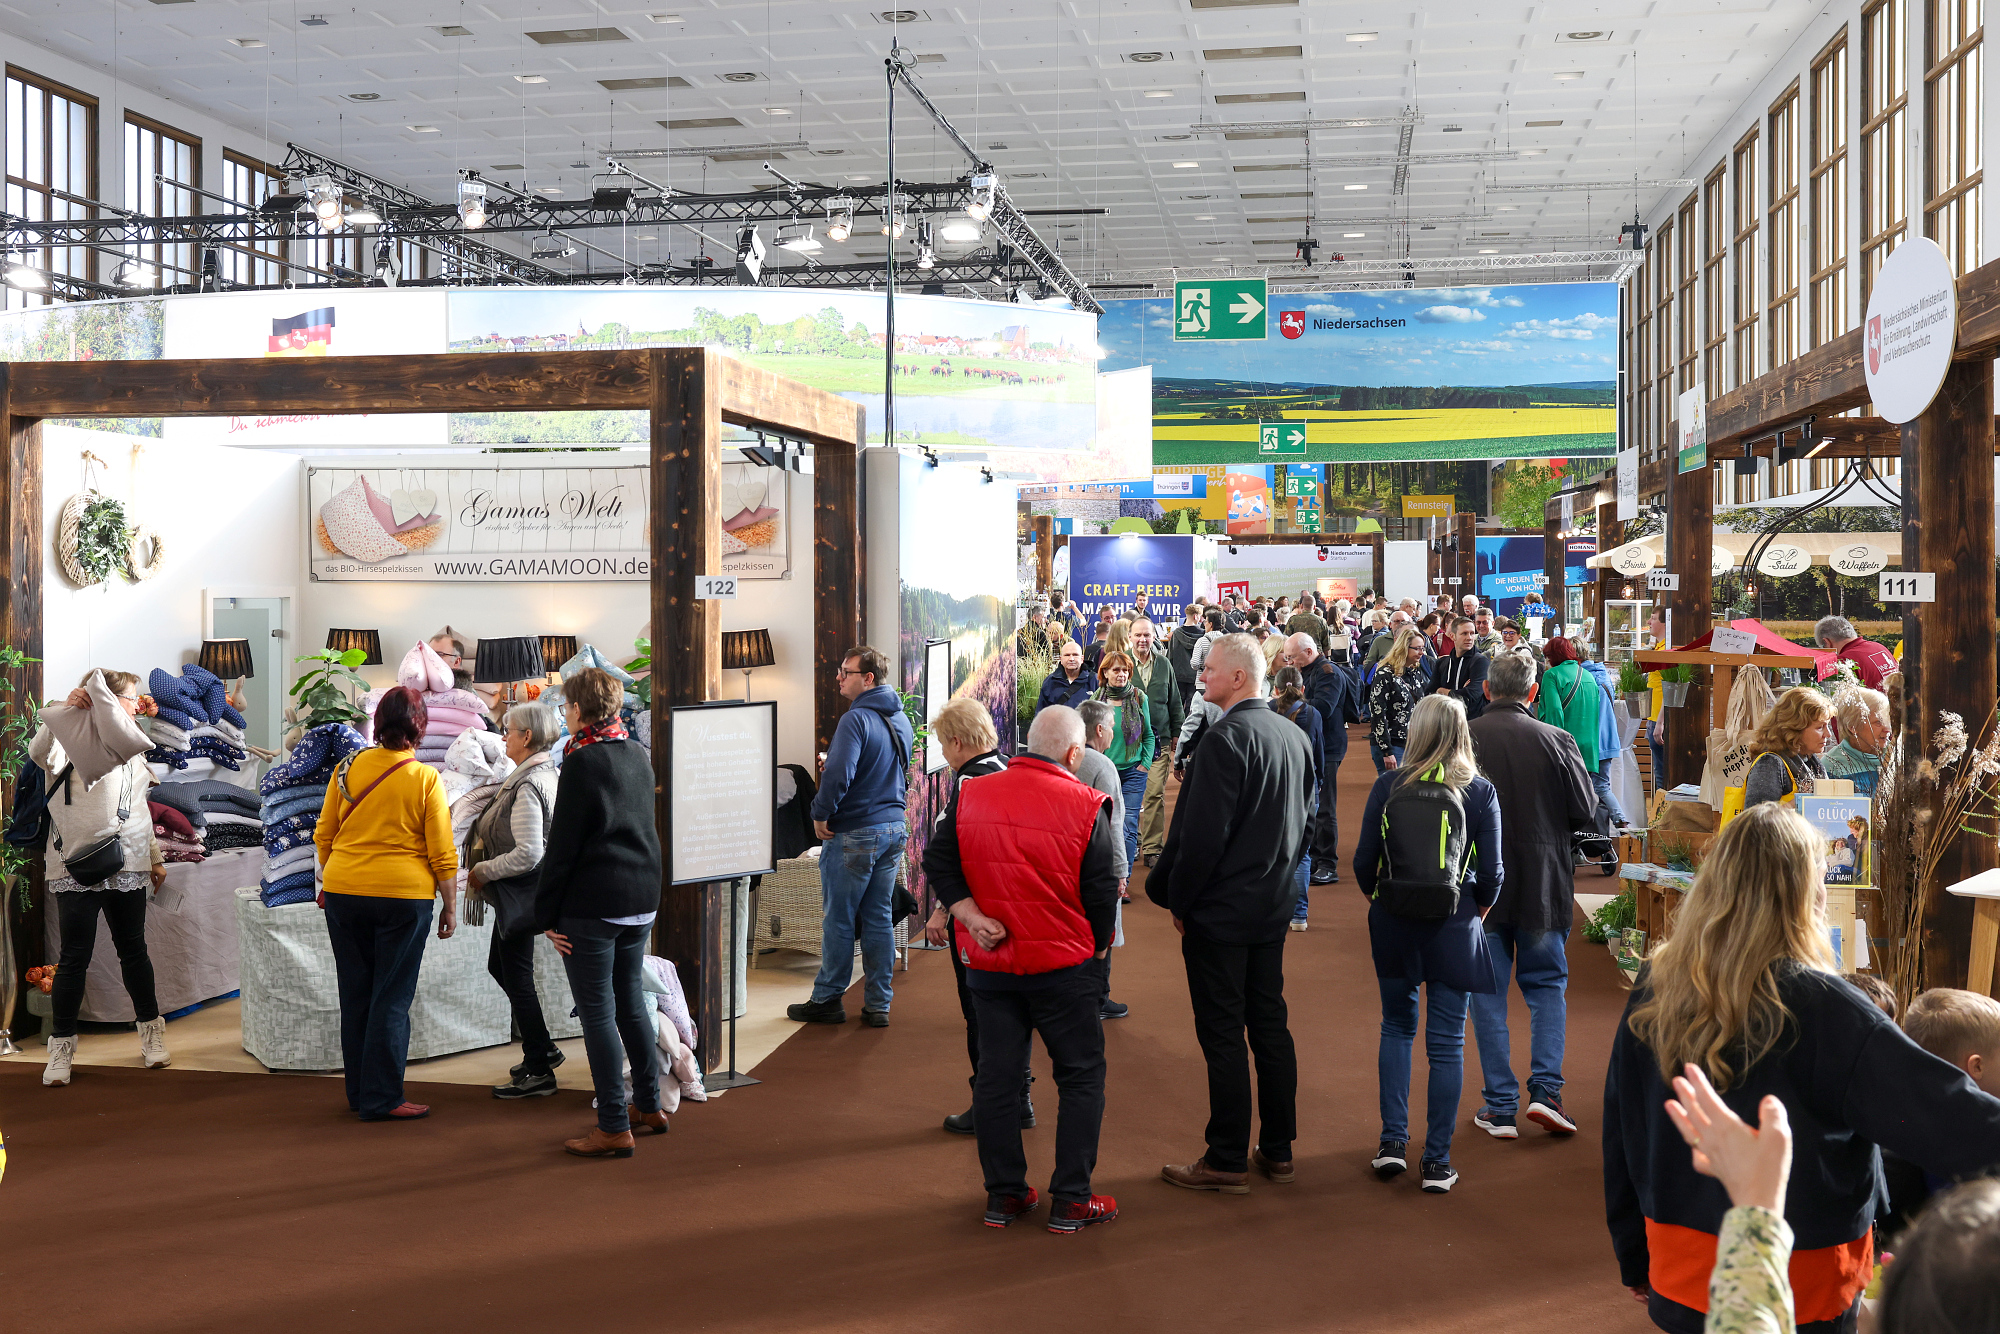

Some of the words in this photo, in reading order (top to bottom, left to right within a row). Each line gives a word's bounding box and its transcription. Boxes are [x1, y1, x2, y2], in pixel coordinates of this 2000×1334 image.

[1884, 303, 1918, 329] Niedersächsisches
[1920, 289, 1947, 312] Ministerium
[1313, 318, 1406, 330] Niedersachsen
[1892, 334, 1930, 359] Verbraucherschutz
[460, 488, 550, 527] Gamas
[560, 485, 624, 520] Welt
[1407, 500, 1449, 510] Rennsteig
[485, 522, 510, 532] einfach
[540, 523, 551, 532] für
[554, 521, 582, 532] Augen
[602, 521, 628, 530] Seele!
[340, 565, 423, 574] BIO-Hirsespelzkissen
[434, 557, 649, 576] www.GAMAMOON.de
[722, 562, 774, 572] espelzkissen
[706, 581, 734, 595] 122
[1651, 577, 1670, 587] 110
[1884, 578, 1916, 596] 111
[1083, 584, 1180, 597] CRAFT-BEER?
[1083, 602, 1137, 615] MAHE
[1152, 603, 1181, 615] WIR
[689, 722, 737, 744] Wusstest
[1724, 750, 1738, 763] Bei
[1740, 744, 1749, 755] di
[729, 758, 752, 766] Gehalts
[696, 771, 732, 779] Kieselsäure
[689, 779, 744, 790] schlaffördernden
[682, 791, 726, 801] beruhigenden
[696, 812, 728, 821] Außerdem
[1818, 806, 1856, 820] GLÜCK
[688, 822, 726, 831] Hirsekissen
[742, 819, 756, 827] gute
[705, 841, 747, 851] Beschwerden
[685, 852, 732, 864] gegenzuwirken
